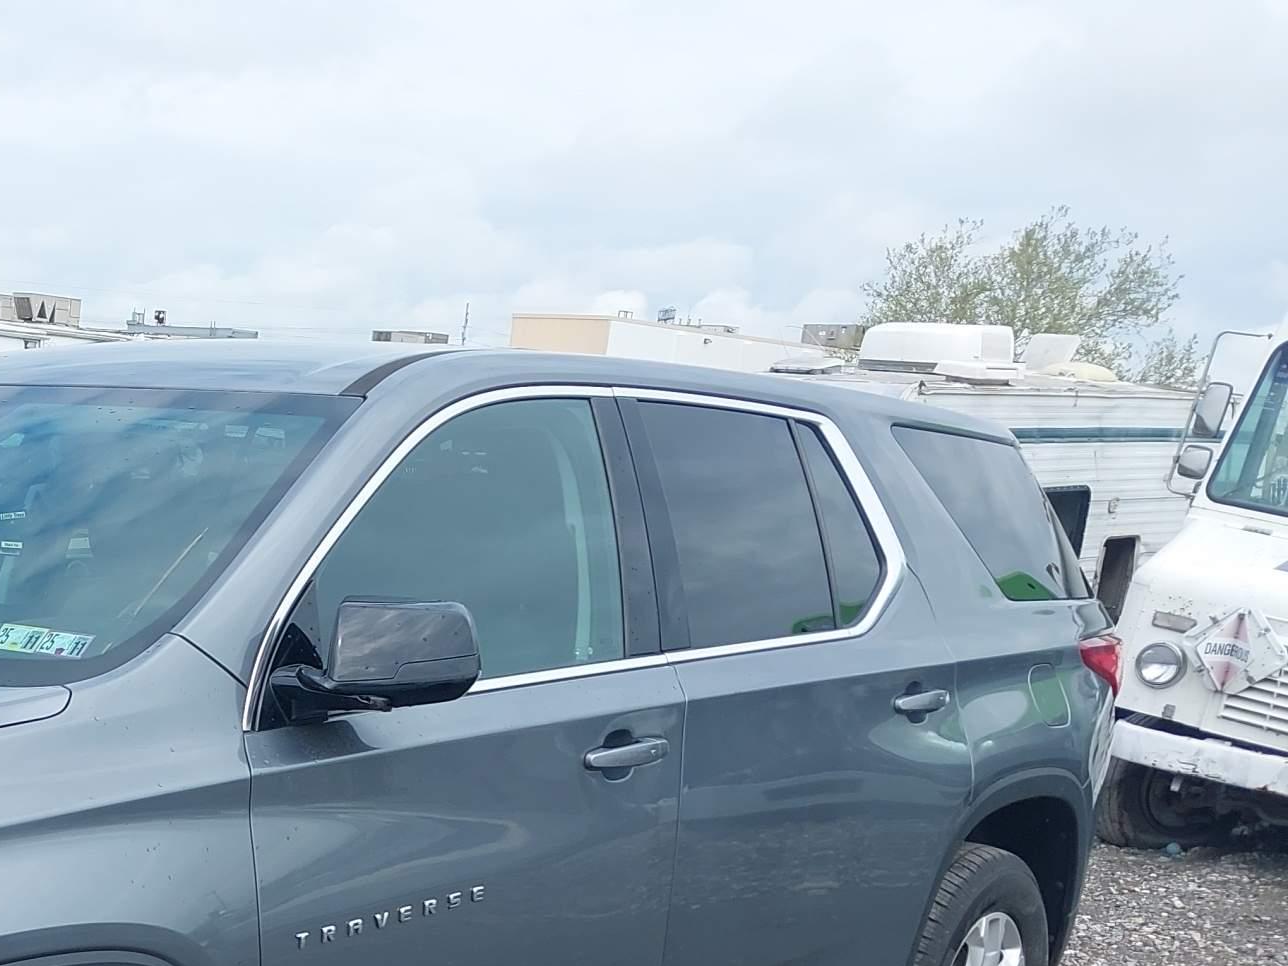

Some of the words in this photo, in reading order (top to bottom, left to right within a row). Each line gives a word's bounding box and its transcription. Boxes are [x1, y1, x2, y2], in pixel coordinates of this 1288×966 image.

[39, 633, 59, 650] 25
[1204, 642, 1250, 663] DANGEROUS
[295, 885, 485, 950] TRAVERSE
